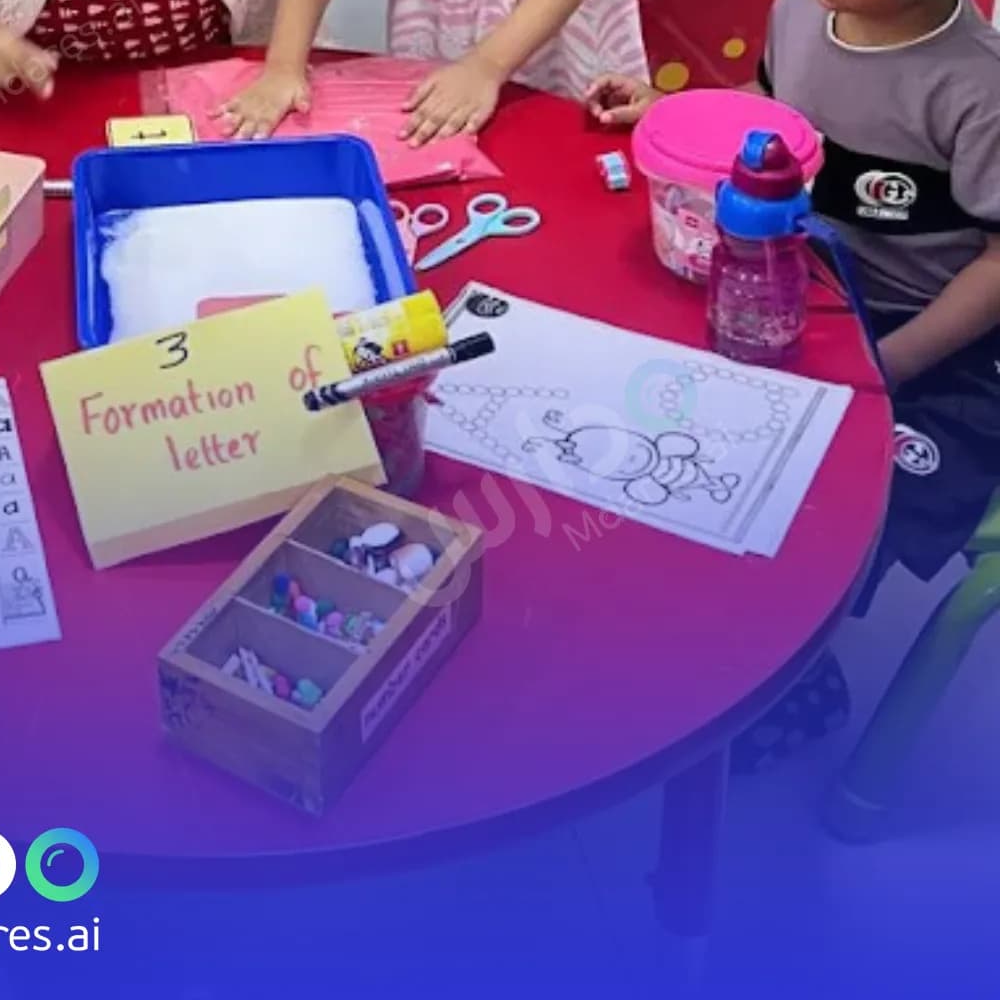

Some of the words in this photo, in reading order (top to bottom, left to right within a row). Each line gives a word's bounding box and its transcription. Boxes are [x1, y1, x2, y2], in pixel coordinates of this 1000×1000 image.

[155, 330, 189, 369] 3
[80, 379, 255, 435] Formation
[286, 345, 323, 396] of
[166, 430, 261, 473] letter
